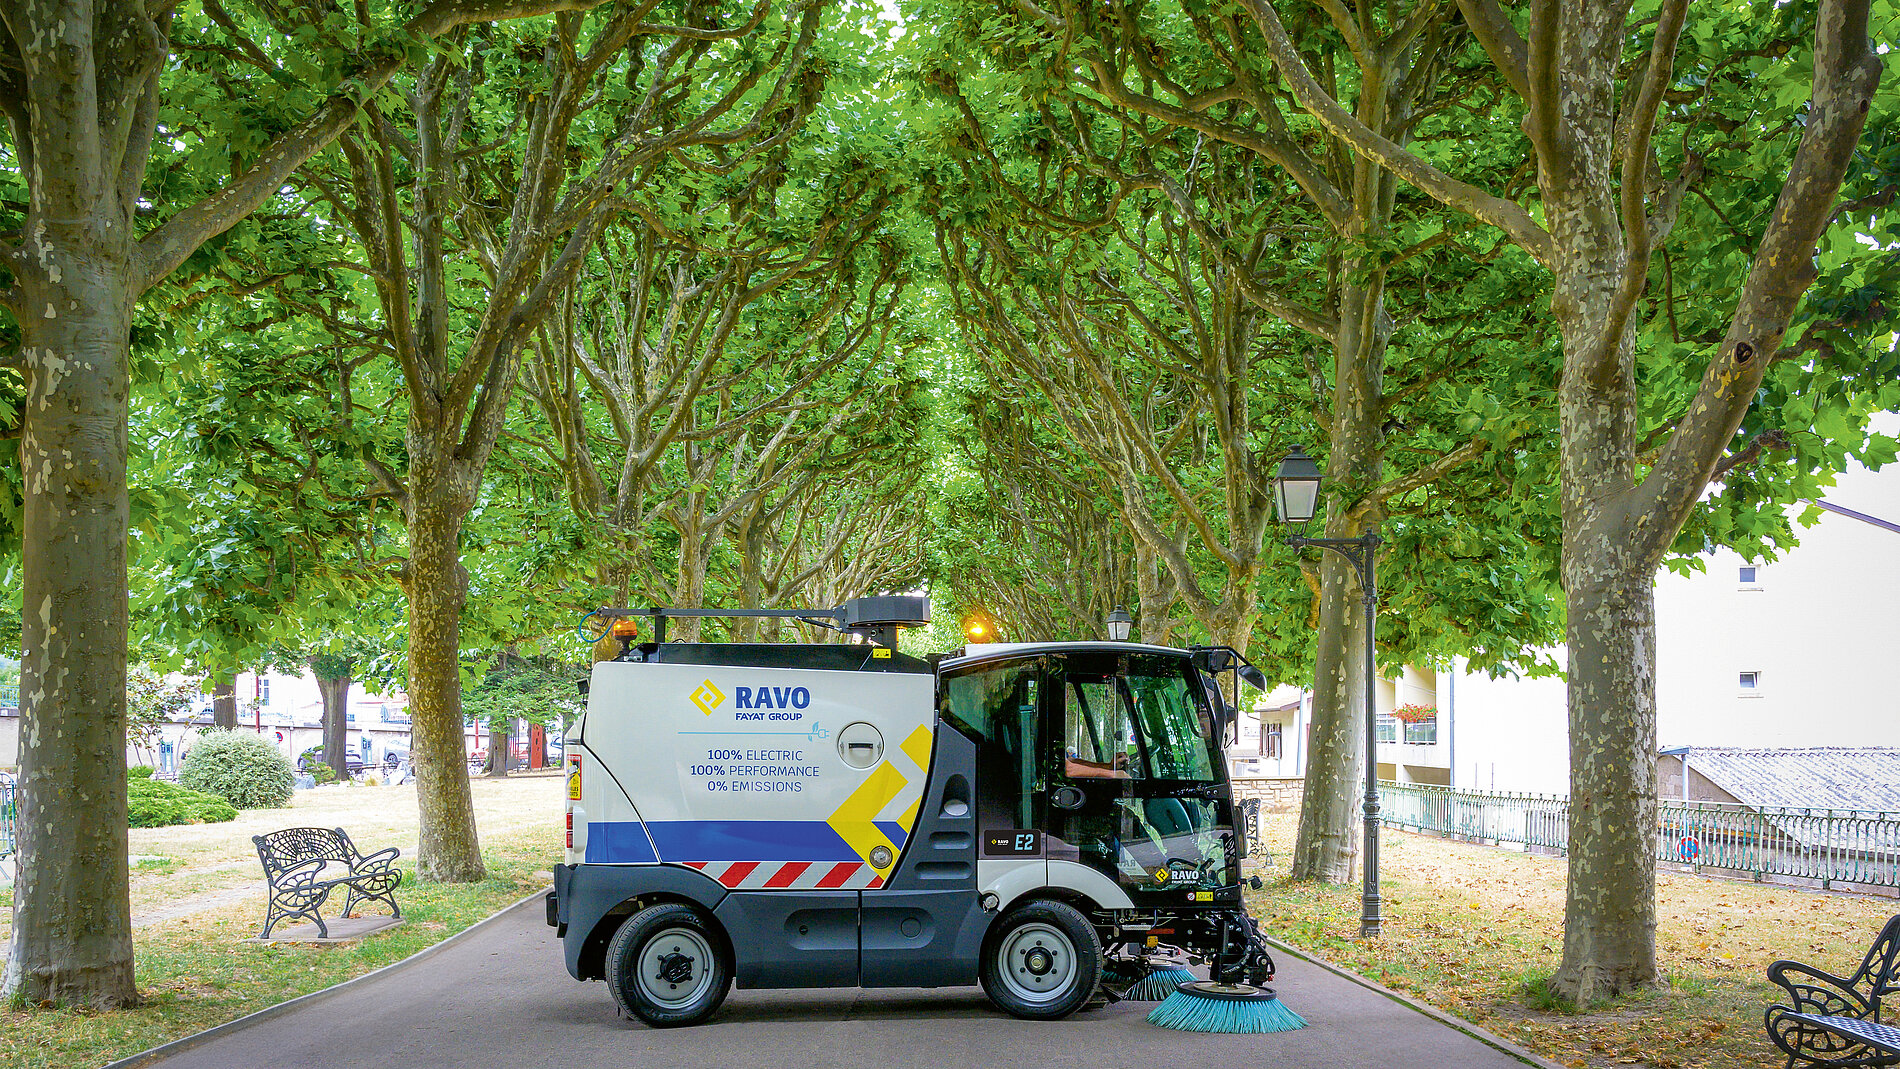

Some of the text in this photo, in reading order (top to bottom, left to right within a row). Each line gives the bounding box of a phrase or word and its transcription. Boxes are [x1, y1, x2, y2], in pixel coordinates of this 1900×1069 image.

[735, 686, 811, 709] RAVO
[735, 712, 803, 721] FAYAT GROUP
[707, 749, 803, 761] 100% ELECTRIC
[690, 765, 820, 777] 100% PERFORMANCE
[707, 780, 802, 792] 0% EMISSIONS
[1014, 833, 1034, 851] E2
[1171, 870, 1200, 880] RAVO
